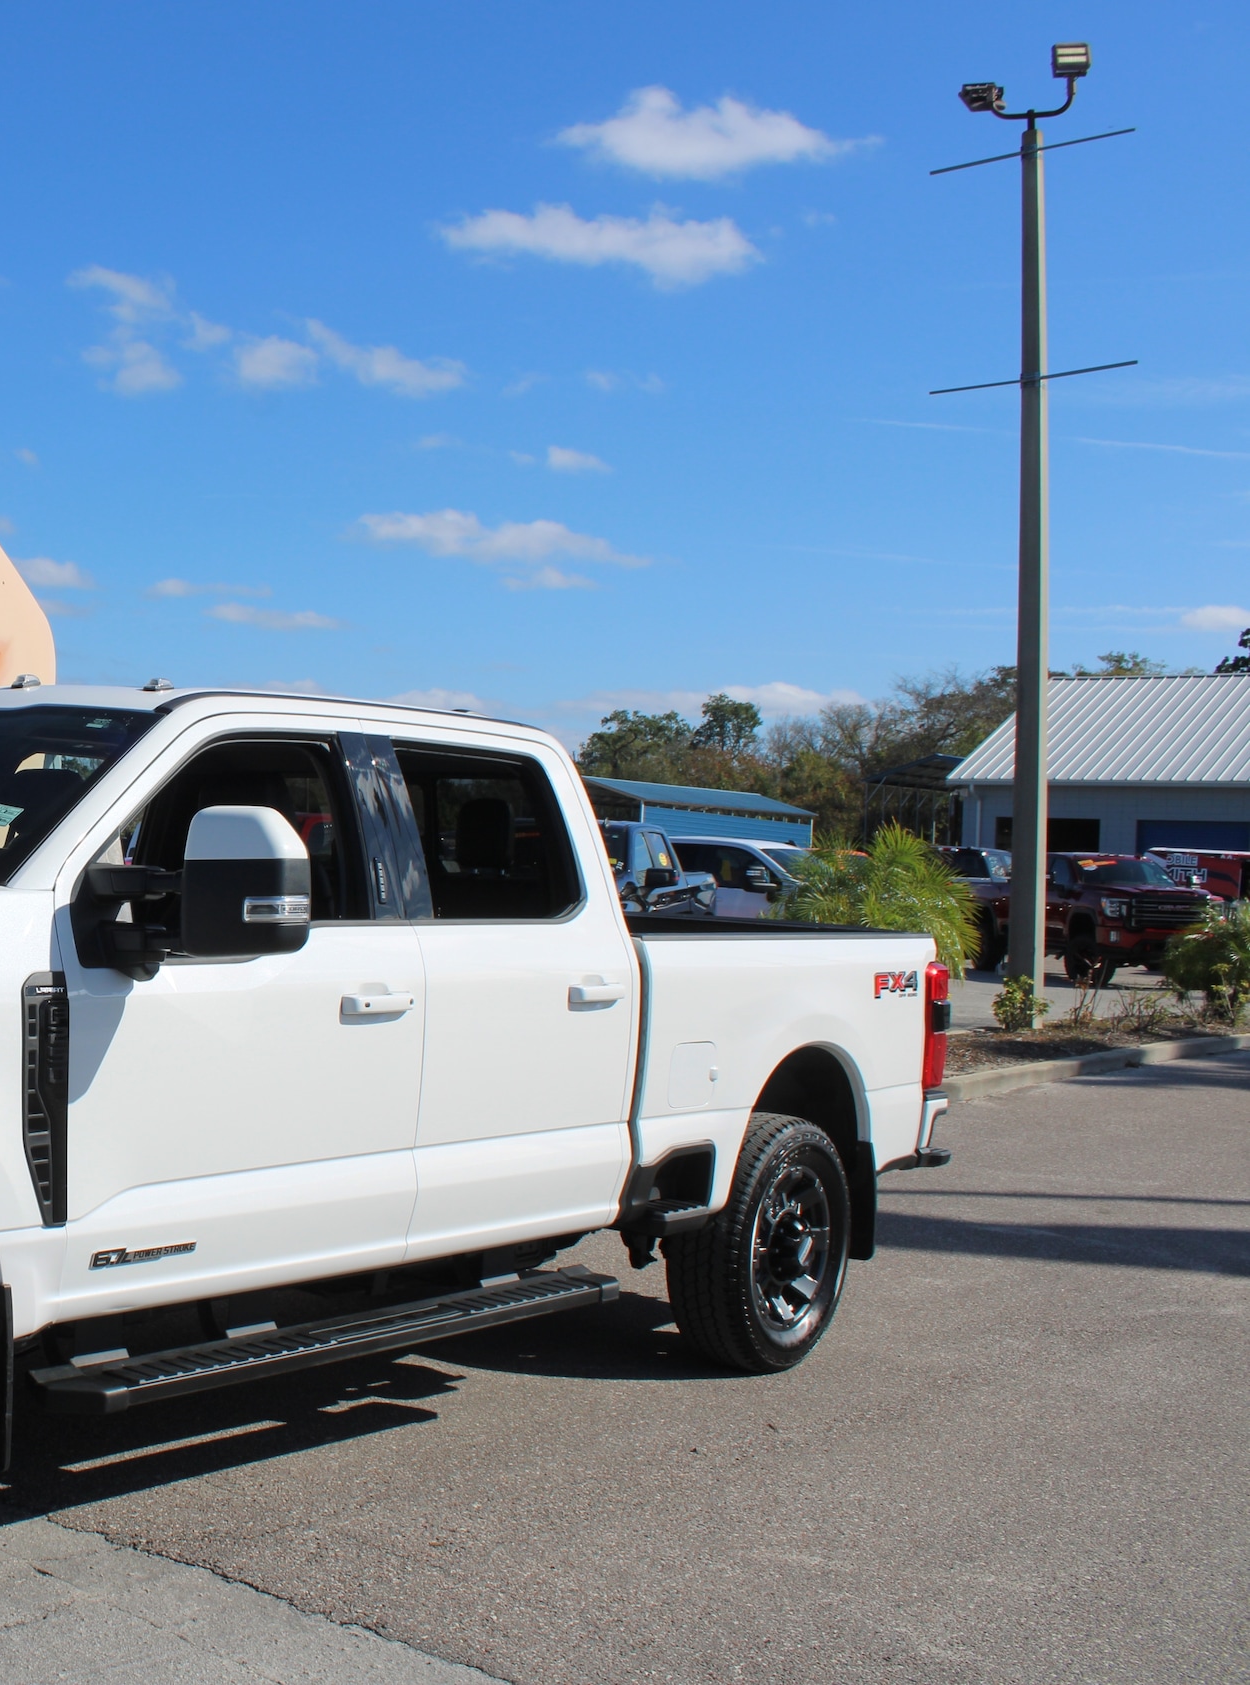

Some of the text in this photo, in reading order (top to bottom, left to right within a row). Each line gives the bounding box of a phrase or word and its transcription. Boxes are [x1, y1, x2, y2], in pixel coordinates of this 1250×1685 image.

[1166, 853, 1198, 866] OBILE
[873, 970, 918, 999] FX4
[133, 1247, 162, 1259] POWER
[163, 1242, 196, 1255] STROKE
